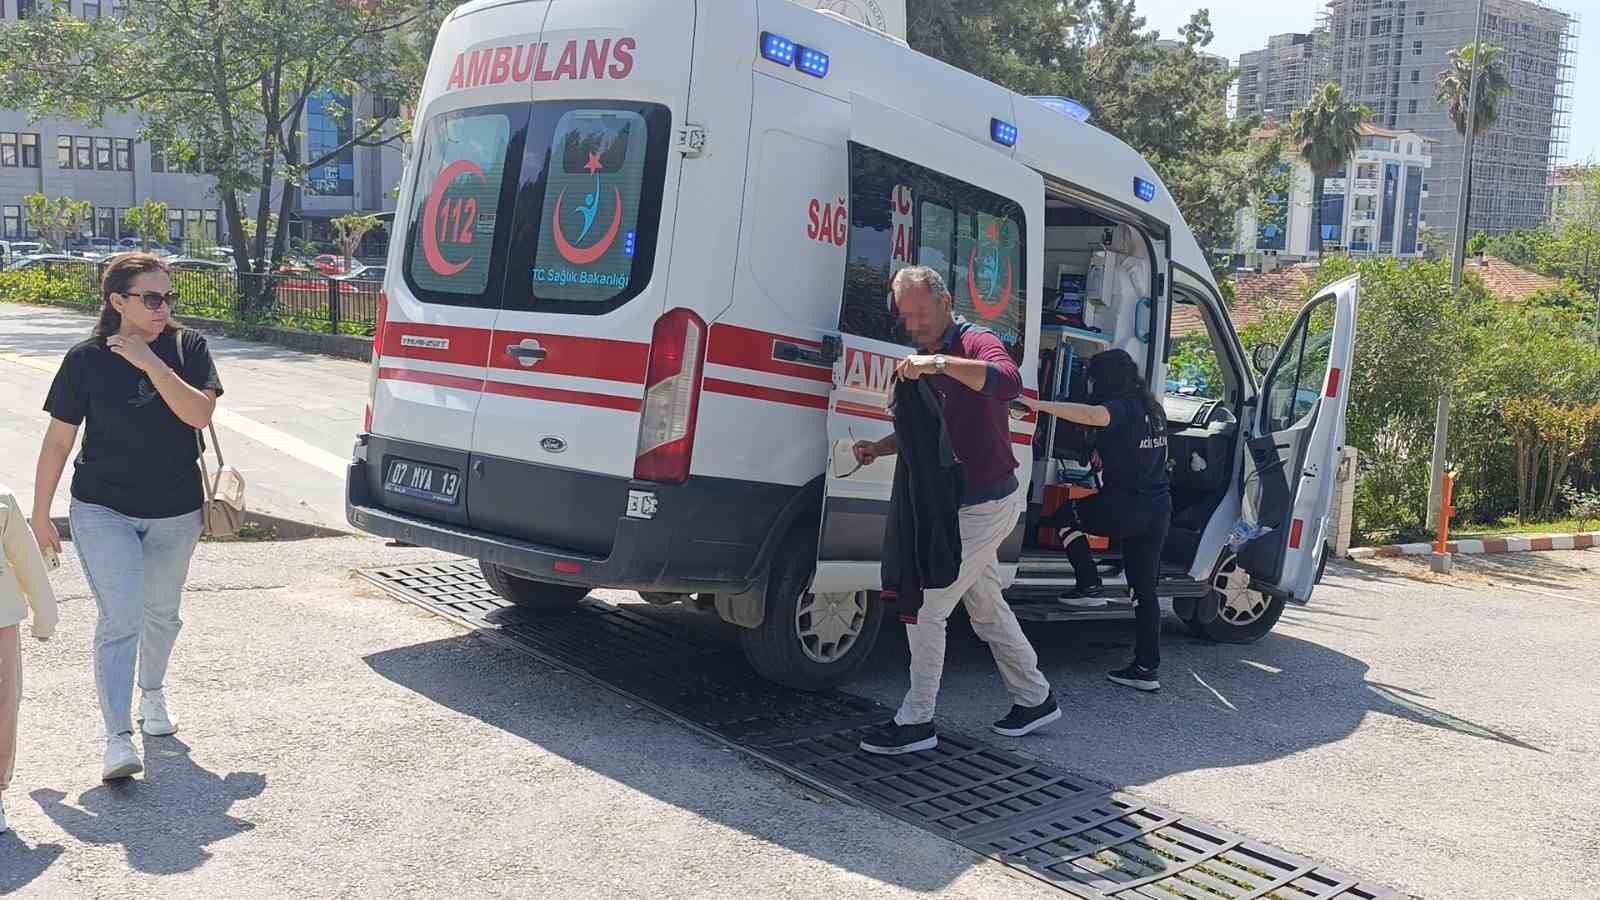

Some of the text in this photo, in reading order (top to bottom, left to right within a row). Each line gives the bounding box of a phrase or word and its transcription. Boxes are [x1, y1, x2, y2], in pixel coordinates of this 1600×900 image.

[447, 37, 636, 91] AMBULANS
[439, 198, 477, 244] 112
[808, 196, 847, 246] SAĞ
[547, 267, 577, 285] Sağlık
[848, 351, 892, 393] AM
[392, 463, 408, 484] 07
[442, 472, 457, 495] 13
